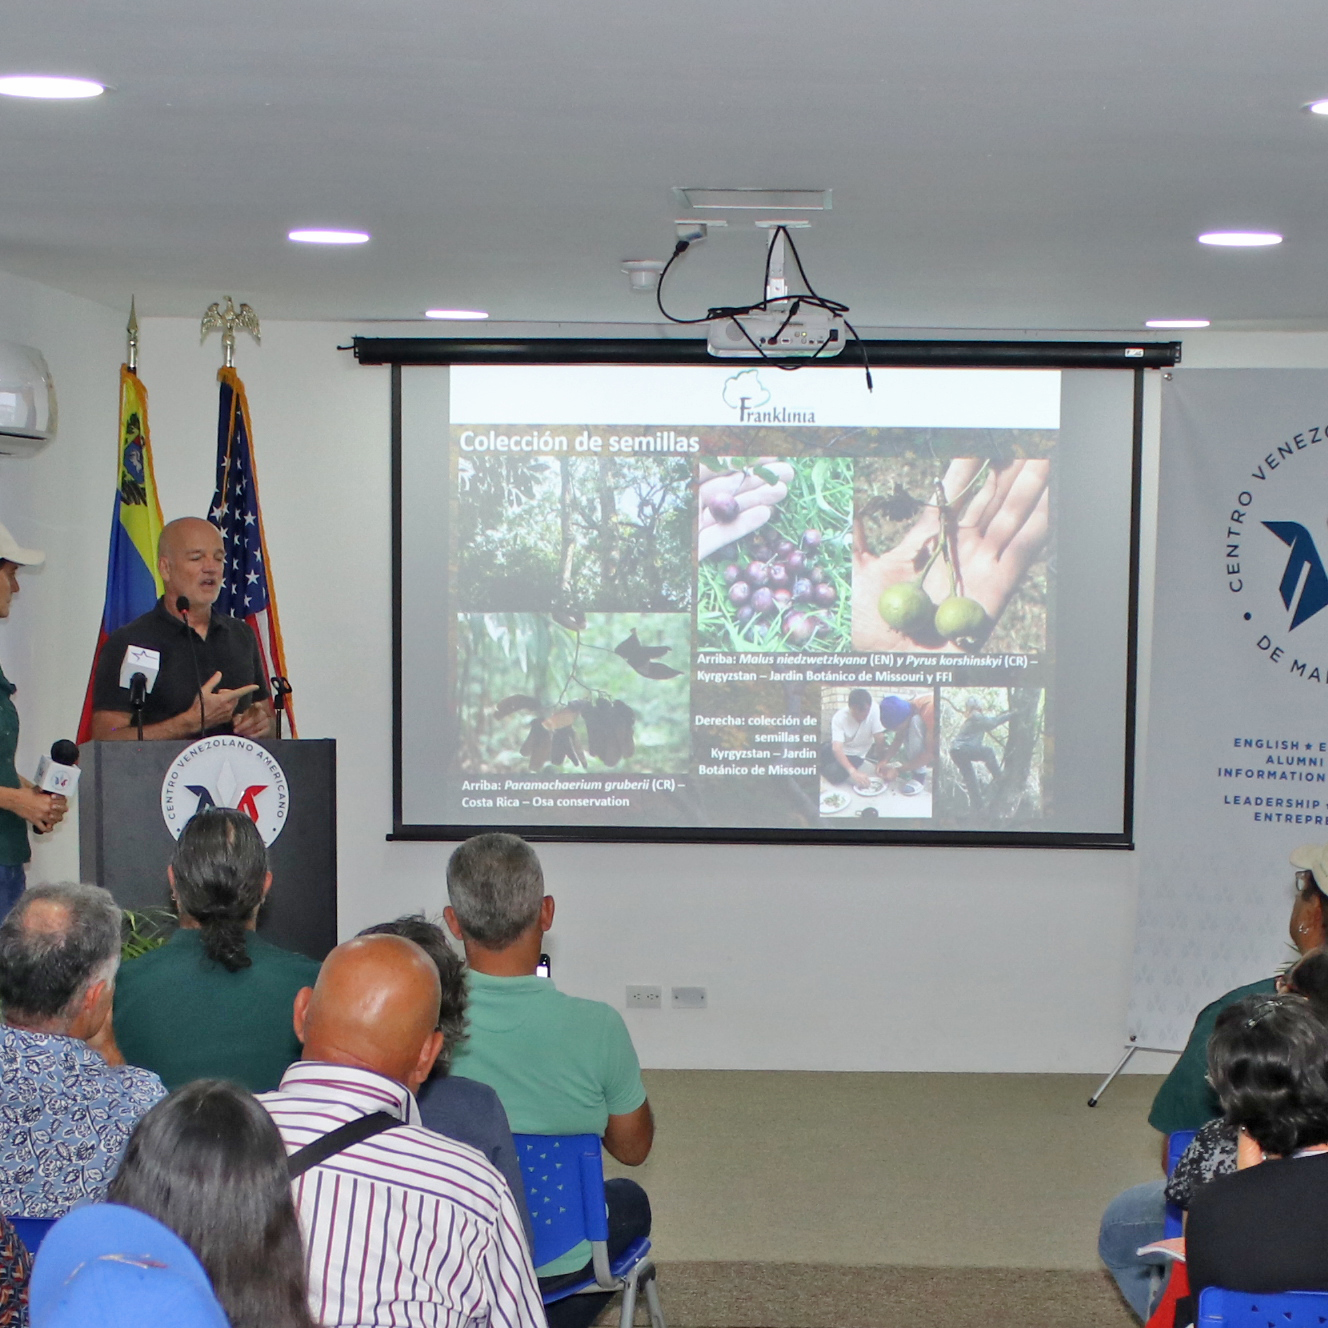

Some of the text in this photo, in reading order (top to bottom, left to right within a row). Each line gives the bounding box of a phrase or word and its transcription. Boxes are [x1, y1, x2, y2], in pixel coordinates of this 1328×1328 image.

[737, 397, 816, 424] Franklinia
[460, 430, 700, 453] Colección de semillas
[1226, 491, 1253, 593] CENTRO
[1256, 635, 1284, 663] DE
[697, 653, 736, 665] Arriba:
[739, 653, 774, 665] Malus
[776, 653, 868, 667] niedzwetzkyana
[870, 654, 894, 667] (EN)
[896, 656, 904, 667] y
[906, 655, 937, 667] Pyrus
[939, 655, 1002, 668] korshinskyi
[1004, 655, 1028, 668] (CR)
[697, 670, 757, 683] Kyrgyzstan
[769, 670, 803, 682] Jardin
[806, 670, 855, 682] Botánico
[858, 670, 873, 682] de
[875, 671, 924, 682] Missouri
[926, 673, 934, 684] y
[936, 672, 953, 682] FFI
[695, 714, 818, 726] Derecha: colección de
[755, 731, 817, 742] semillas en
[1234, 738, 1300, 751] ENGLISH
[711, 747, 770, 760] Kyrgyzstan
[783, 747, 817, 759] Jardin
[1266, 755, 1324, 768] ALUMNI
[699, 764, 817, 775] Botánico de Missouri
[1217, 767, 1326, 783] INFORMATION
[166, 739, 286, 820] CENTRO VENEZOLANO AMERICANO
[462, 780, 501, 790] Arriba:
[504, 779, 602, 791] Paramachaerium
[604, 779, 650, 792] gruberii
[651, 779, 675, 792] (CR)
[462, 796, 493, 807] Costa
[496, 796, 520, 807] Rica
[532, 796, 554, 807] Osa
[557, 795, 630, 807] conservation
[1224, 795, 1320, 810] LEADERSHIP
